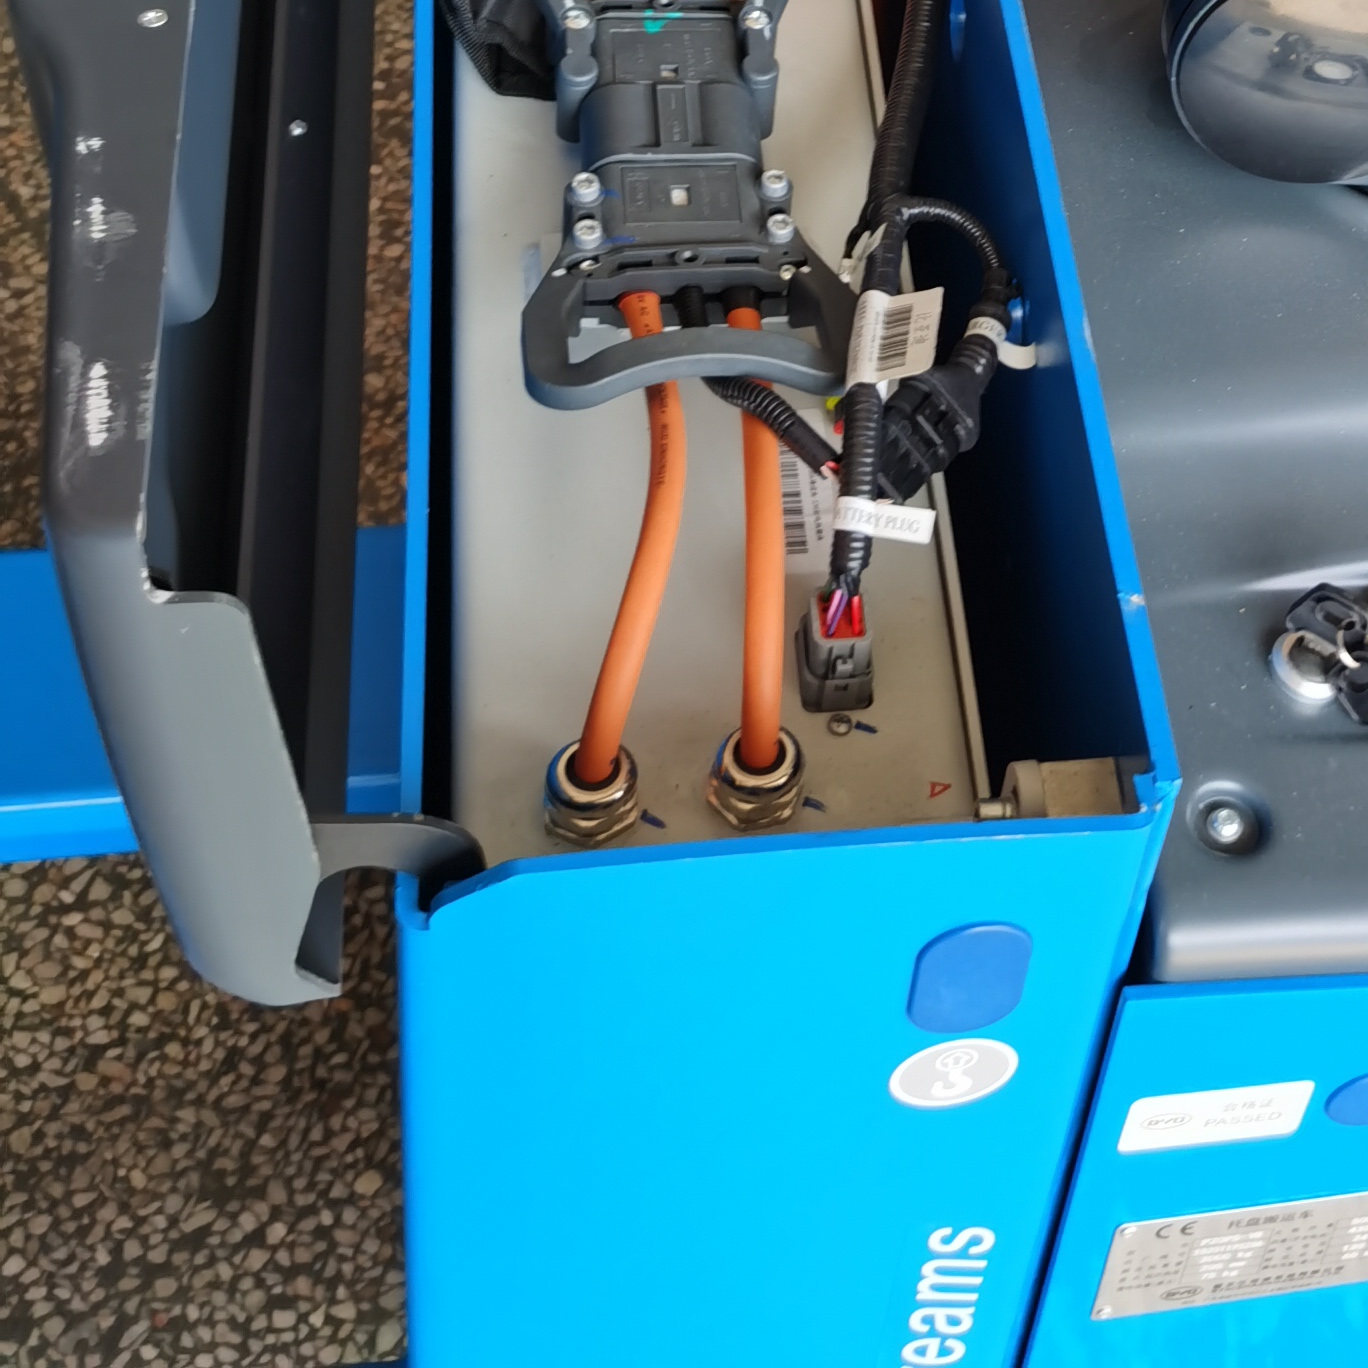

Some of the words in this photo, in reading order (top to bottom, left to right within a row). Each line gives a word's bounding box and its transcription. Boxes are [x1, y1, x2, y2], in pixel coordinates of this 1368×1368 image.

[1203, 1111, 1283, 1128] PASSED
[1155, 1219, 1199, 1239] CE
[899, 1226, 997, 1368] eams
